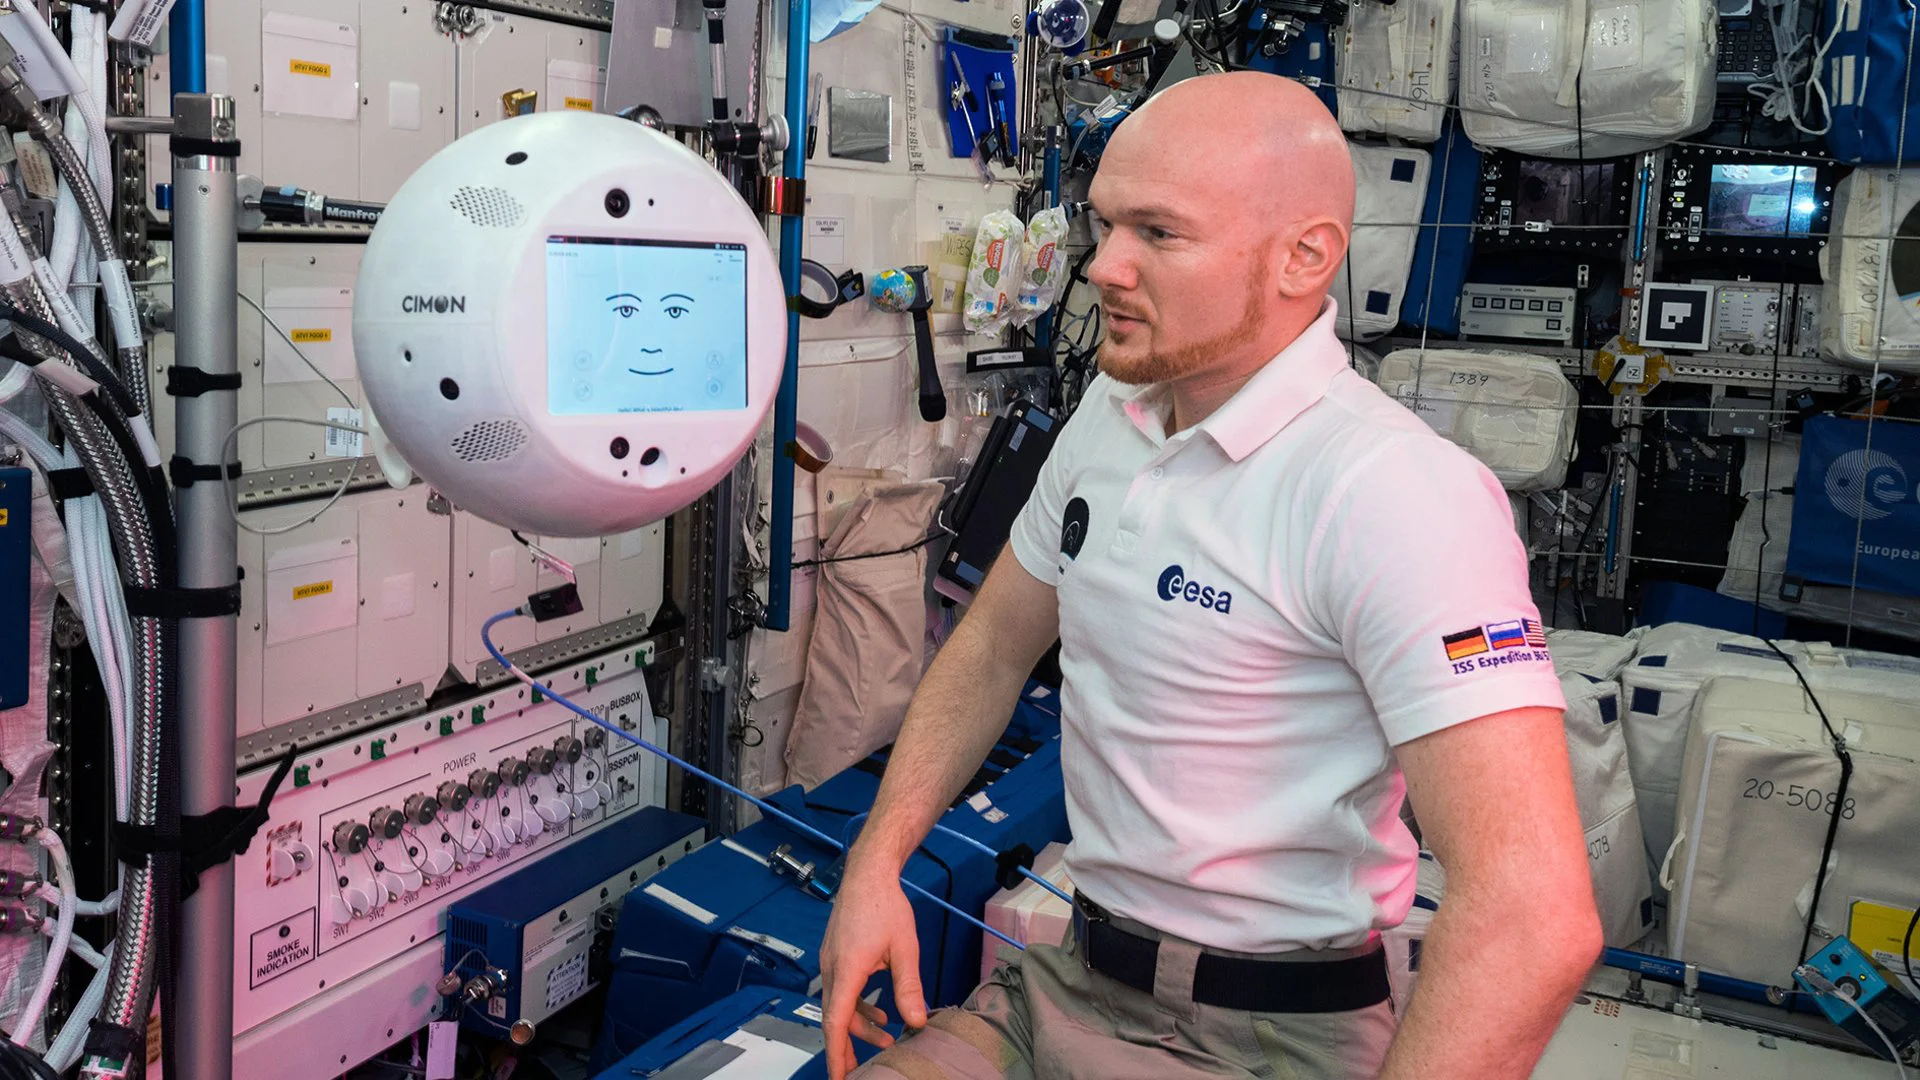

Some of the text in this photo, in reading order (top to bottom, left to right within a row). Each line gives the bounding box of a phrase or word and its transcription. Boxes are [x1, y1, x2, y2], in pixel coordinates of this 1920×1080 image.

[1411, 71, 1429, 112] 1467
[402, 295, 465, 313] CIMON
[1449, 372, 1489, 387] 1389
[1452, 661, 1475, 675] ISS
[1478, 651, 1532, 668] Expedition
[610, 691, 641, 711] BUSBOX
[575, 704, 605, 723] LTOP
[443, 752, 477, 774] POWER
[1743, 778, 1856, 820] 20-5088
[1588, 836, 1610, 860] 078
[403, 890, 420, 907] SW3
[368, 905, 386, 923] SW2
[332, 920, 350, 939] SW1
[266, 939, 300, 962] SMOKE
[256, 946, 310, 978] INDICATION
[553, 963, 580, 982] ATTENTION
